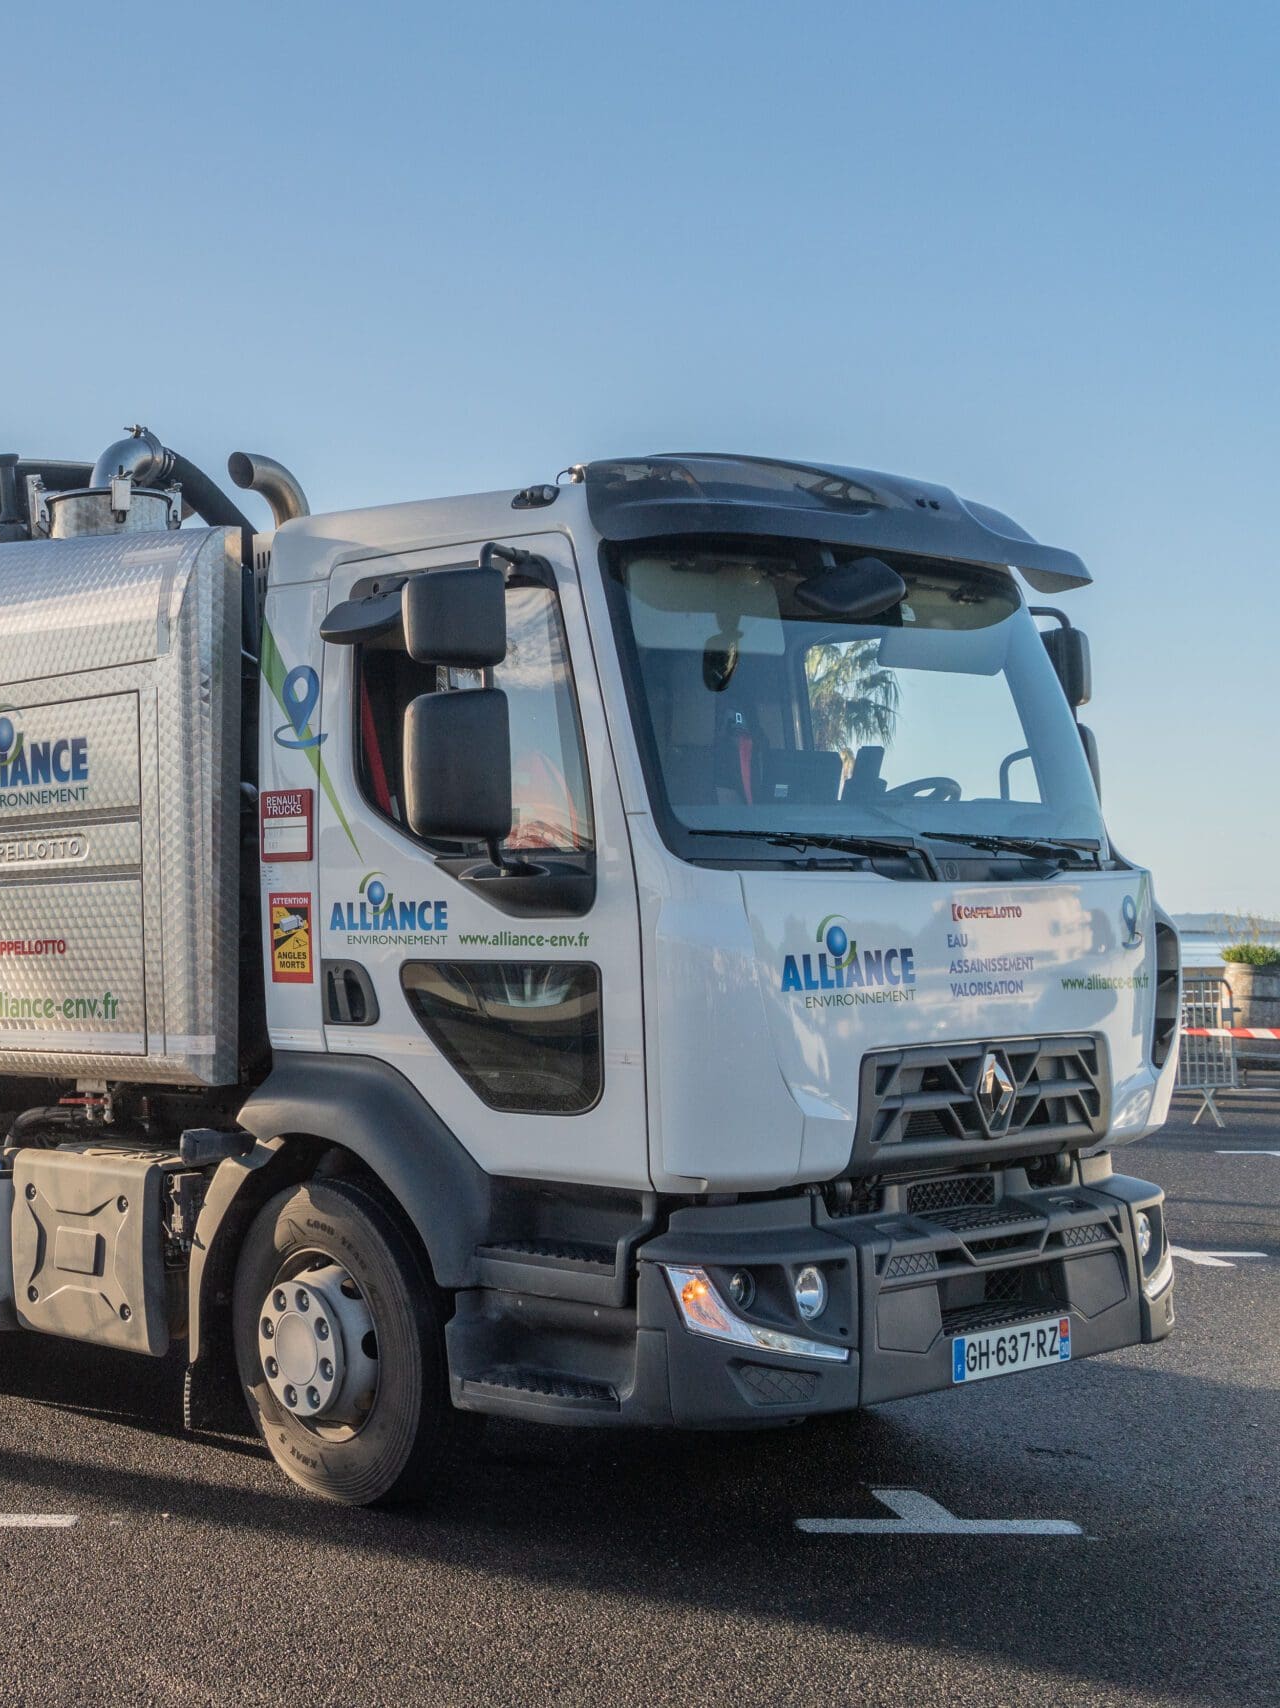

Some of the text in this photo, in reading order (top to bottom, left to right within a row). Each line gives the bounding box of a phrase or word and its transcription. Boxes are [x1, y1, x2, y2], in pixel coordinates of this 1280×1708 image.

[266, 795, 303, 807] RENAULT
[267, 804, 303, 816] TRUCKS
[272, 897, 309, 905] ATTENTION
[329, 900, 448, 932] ALLIANCE
[347, 935, 448, 945] ENVIRONNEMENT
[459, 932, 590, 948] www.alliance-env.fr
[947, 933, 968, 948] EAU
[277, 951, 307, 960] ANGLES
[279, 961, 306, 969] MORTS
[781, 948, 916, 992] ALLIANCE
[949, 957, 1035, 974] ASSAINISSEMENT
[951, 980, 1023, 997] VALORISATION
[805, 989, 917, 1009] ENVIRONNEMENT
[966, 1326, 1060, 1372] GH-637-RZ
